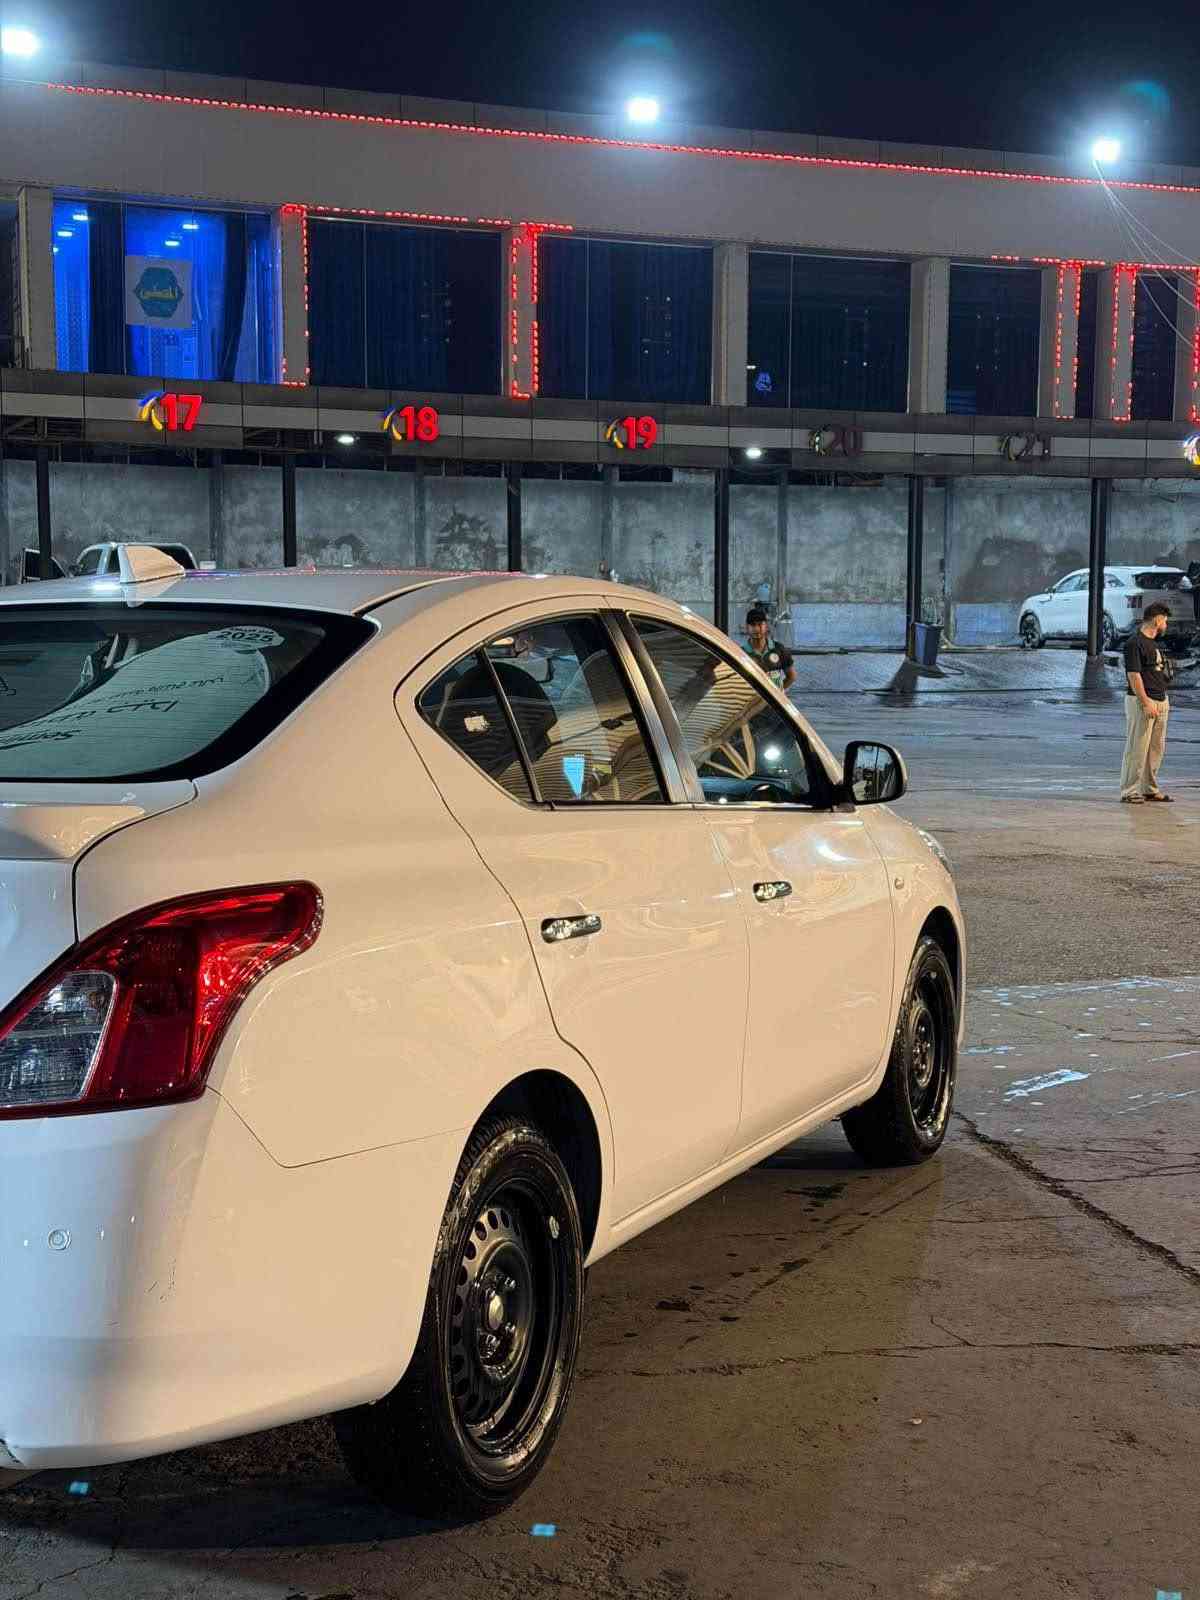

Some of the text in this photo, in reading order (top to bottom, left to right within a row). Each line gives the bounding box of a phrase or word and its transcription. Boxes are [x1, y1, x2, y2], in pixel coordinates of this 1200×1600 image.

[160, 393, 203, 432] 17
[399, 405, 440, 442] 18
[623, 415, 657, 450] 19
